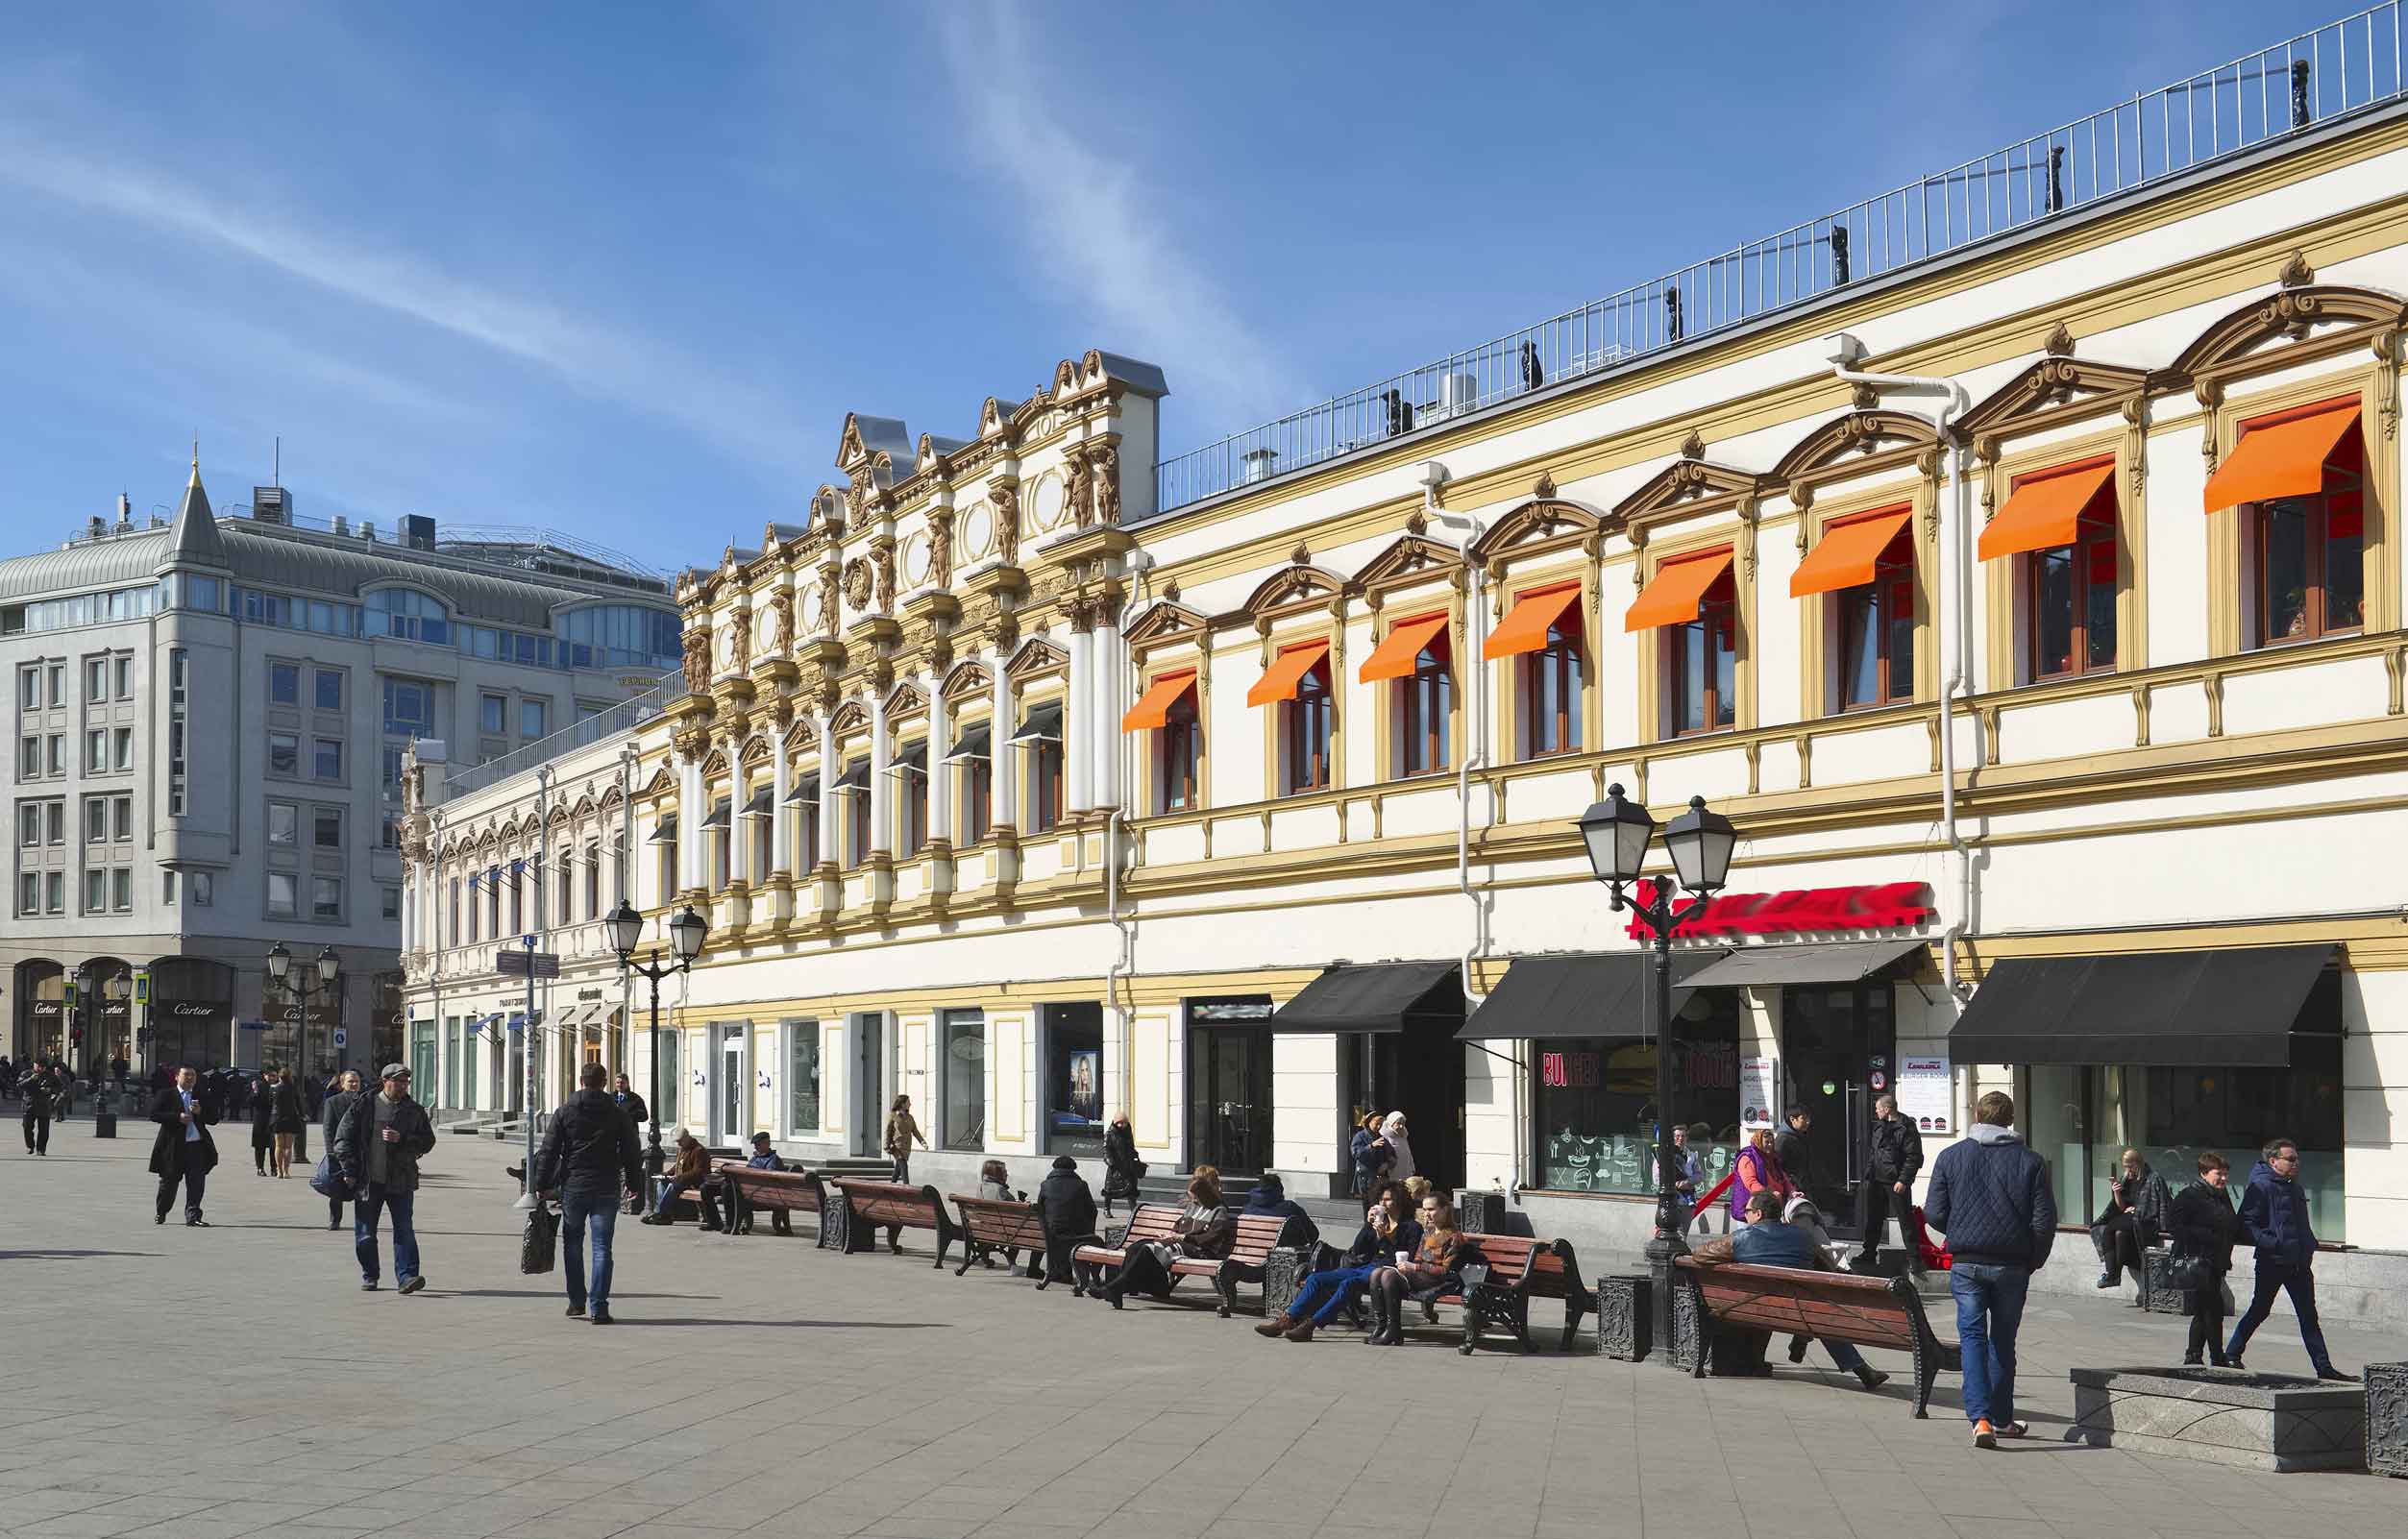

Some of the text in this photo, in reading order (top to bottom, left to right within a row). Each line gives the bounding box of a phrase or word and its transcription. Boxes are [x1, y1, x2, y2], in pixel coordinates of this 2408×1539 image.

[35, 1002, 58, 1014] Cartier
[105, 1003, 125, 1014] artier
[174, 1002, 213, 1015] Cartier
